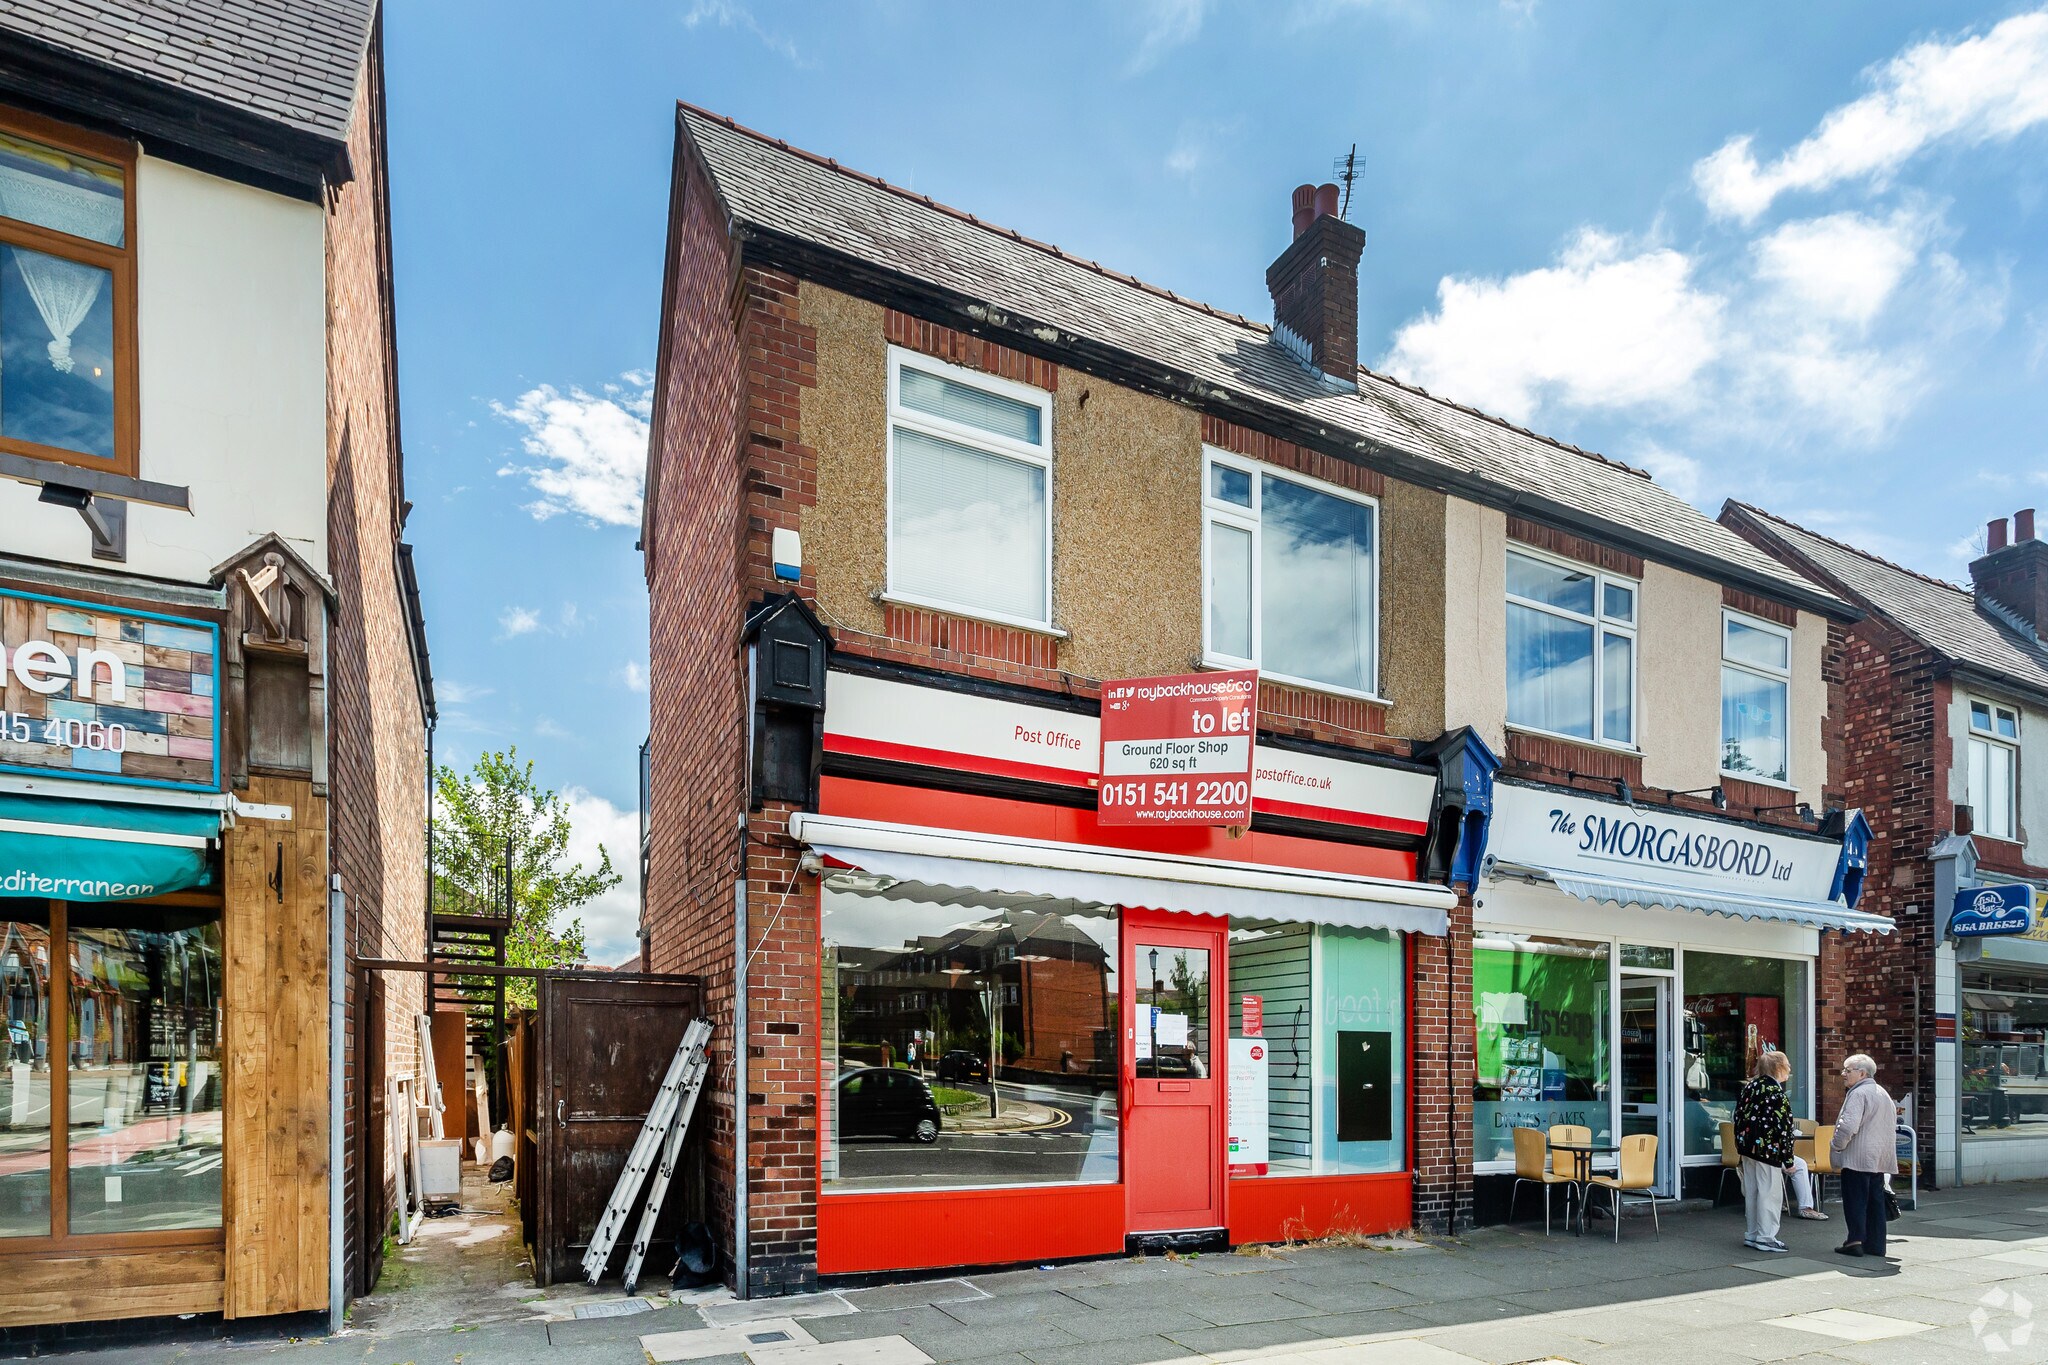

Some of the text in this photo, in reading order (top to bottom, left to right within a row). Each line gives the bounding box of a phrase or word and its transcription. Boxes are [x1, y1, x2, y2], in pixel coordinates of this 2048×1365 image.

[0, 639, 126, 702] en
[1137, 679, 1253, 701] roybackhouse&co
[1192, 707, 1250, 734] to let
[43, 717, 126, 753] 4060
[1014, 725, 1081, 751] Post Office
[1121, 741, 1228, 756] Ground Floor Shop
[1149, 756, 1197, 771] 620 sq ft
[1255, 767, 1332, 790] postoffice.co.uk
[1102, 781, 1248, 806] 0151 541 2200
[1136, 807, 1244, 821] www.roybackhouse.com
[1549, 809, 1793, 880] The SMORGASBORD Ltd
[0, 869, 154, 897] diterranean
[1953, 922, 1977, 932] SEA
[1979, 919, 2025, 931] BREEZE
[1494, 1112, 1541, 1128] DRINKS
[1549, 1111, 1586, 1126] CAKES
